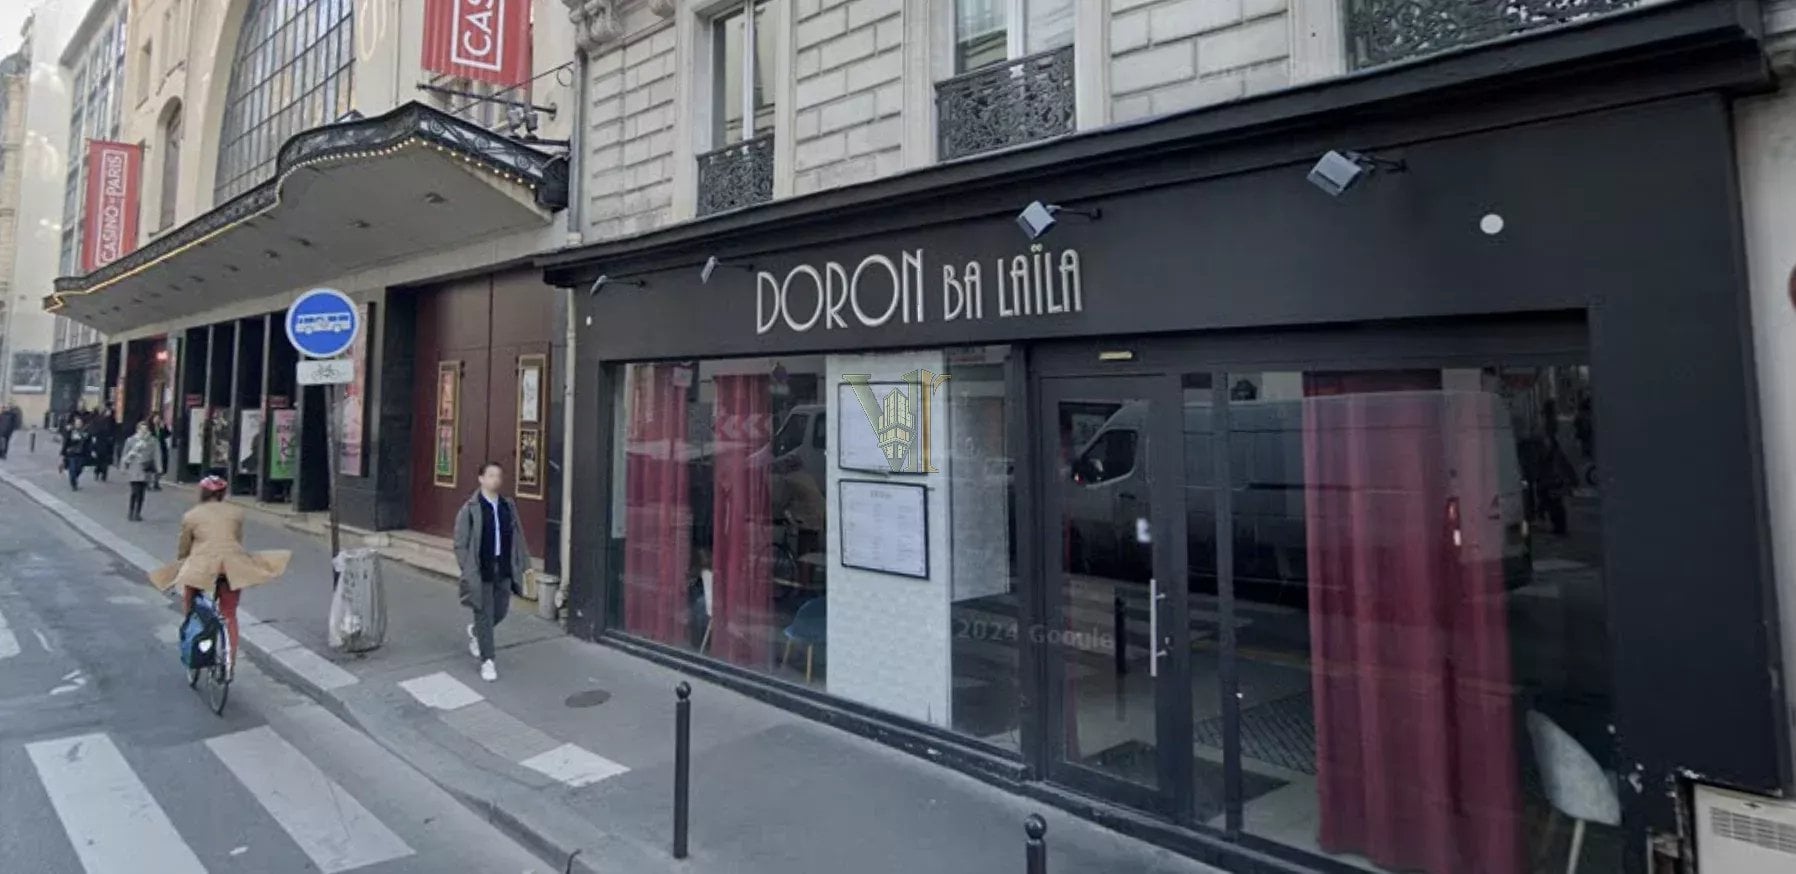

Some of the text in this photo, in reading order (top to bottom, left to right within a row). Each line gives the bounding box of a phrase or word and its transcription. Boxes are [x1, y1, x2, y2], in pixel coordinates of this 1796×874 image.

[106, 153, 124, 196] PARIS
[101, 205, 118, 262] CASINO
[756, 243, 1082, 334] DORON BA LAÏLA
